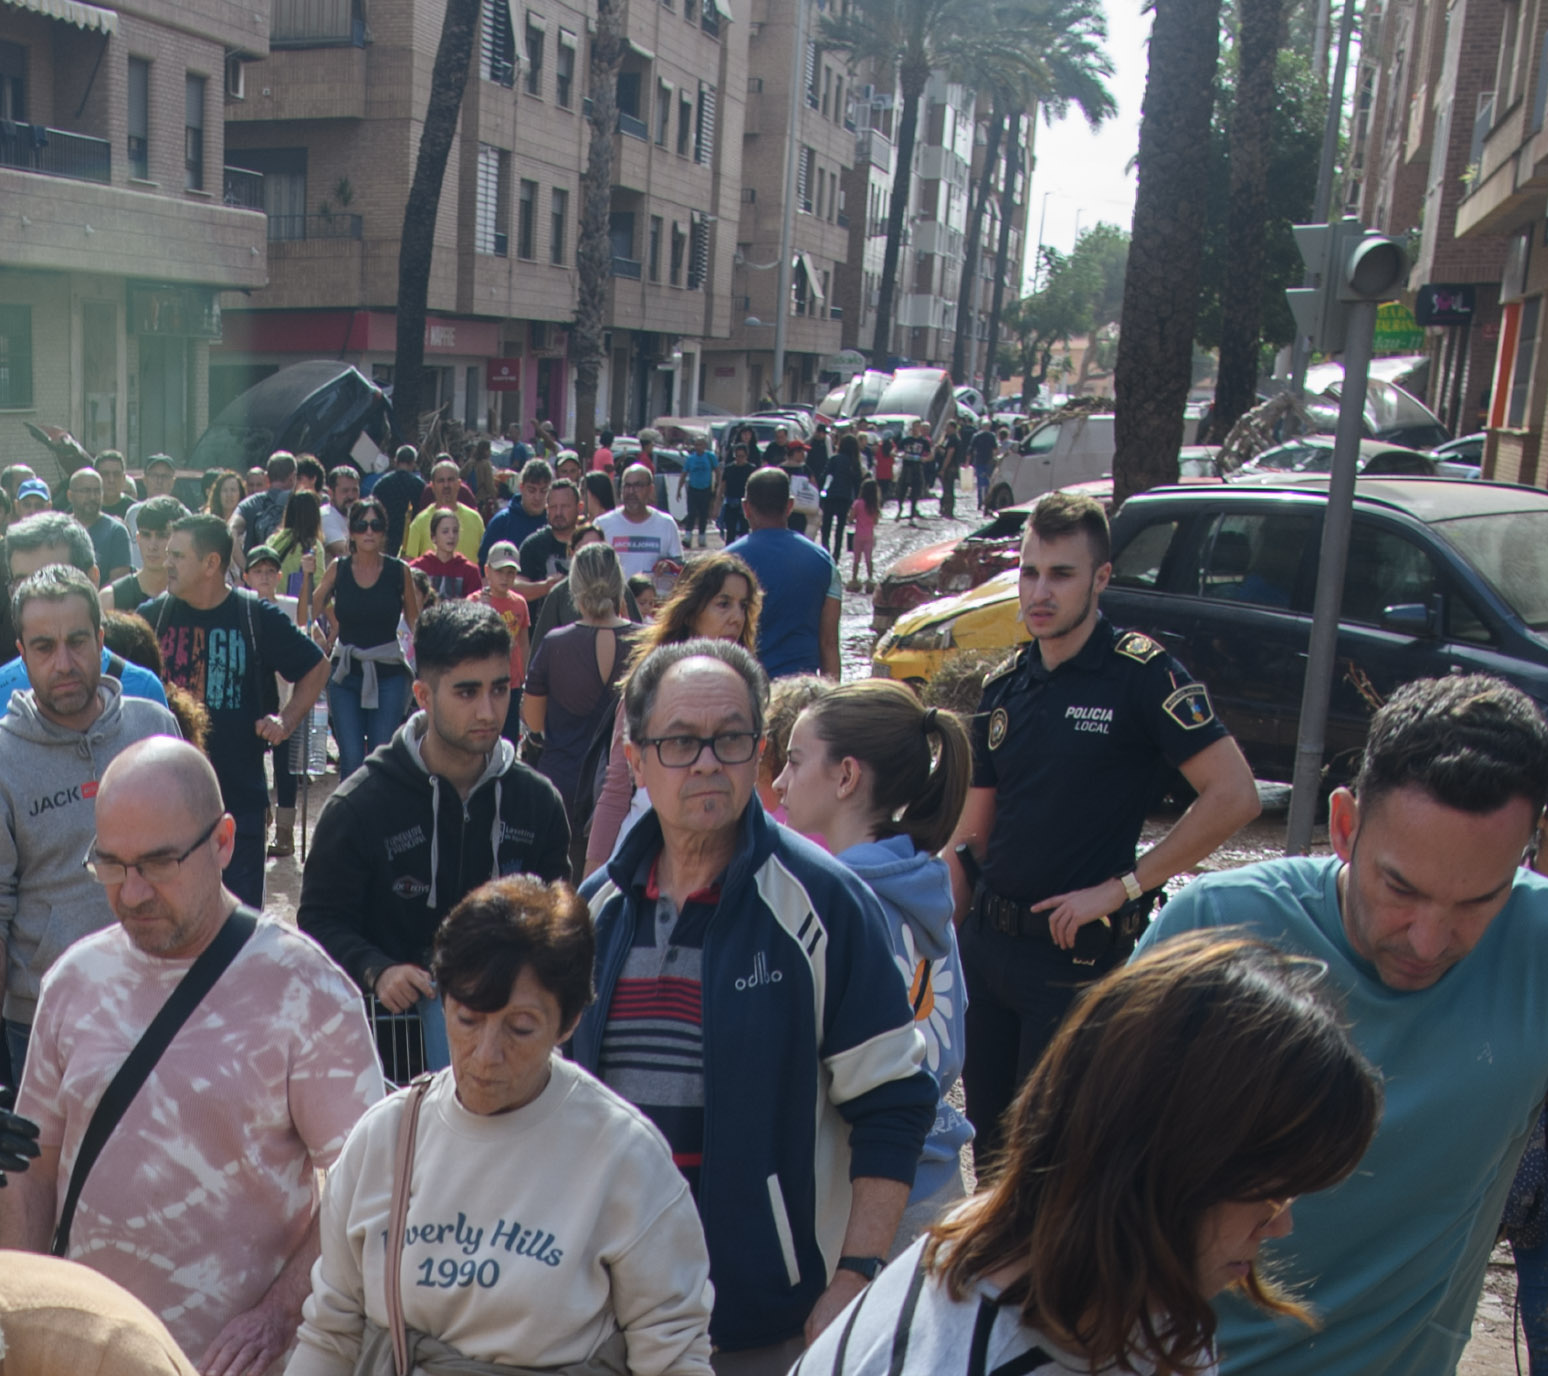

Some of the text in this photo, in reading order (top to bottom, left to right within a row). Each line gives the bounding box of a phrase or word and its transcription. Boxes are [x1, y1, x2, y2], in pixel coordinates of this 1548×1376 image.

[1065, 706, 1113, 722] POLICIA
[1074, 721, 1109, 734] LOCAL
[29, 785, 80, 817] JACK
[490, 1219, 564, 1268] Hills
[416, 1256, 500, 1290] 1990
